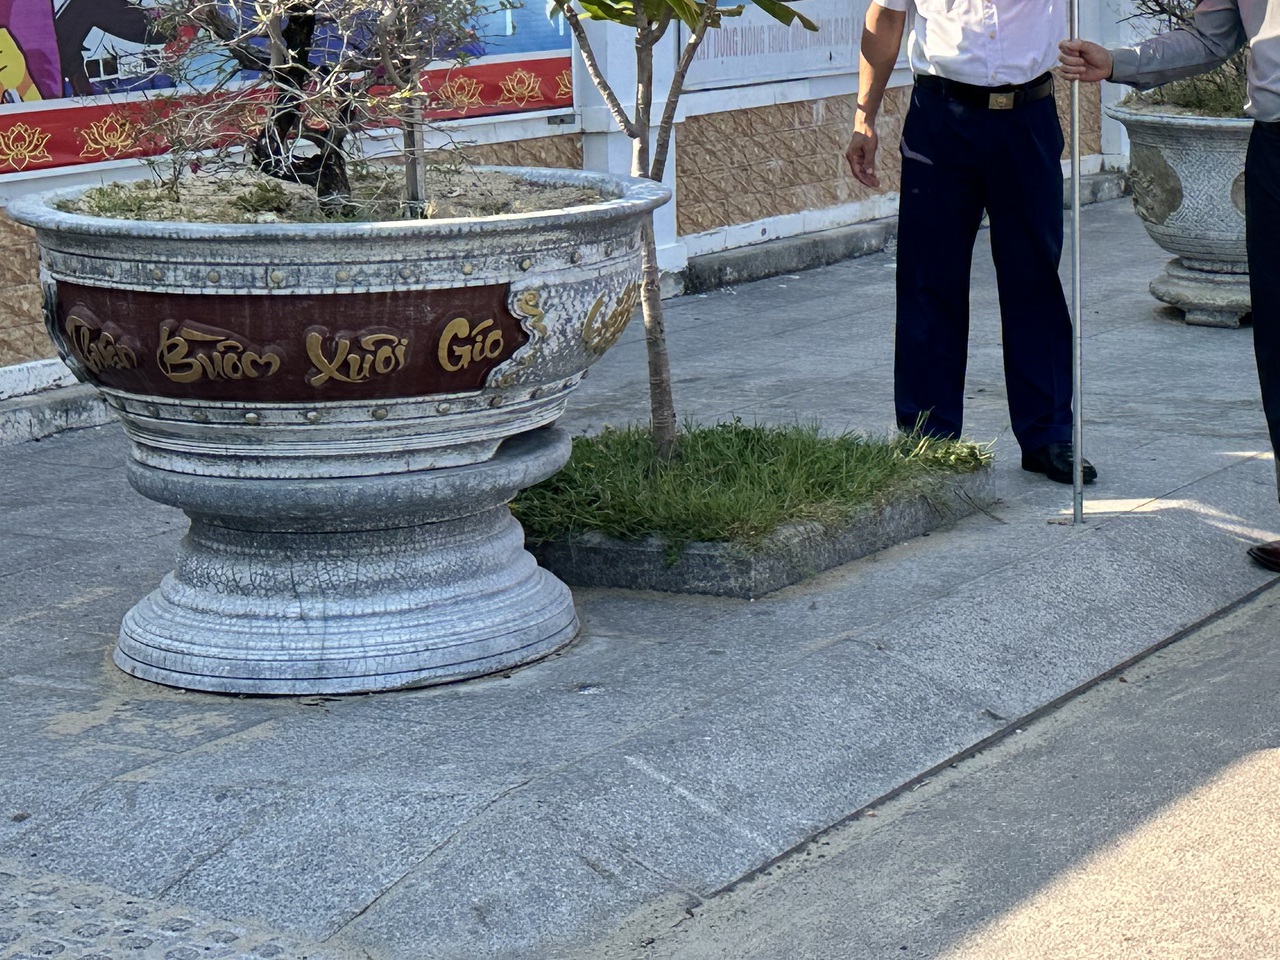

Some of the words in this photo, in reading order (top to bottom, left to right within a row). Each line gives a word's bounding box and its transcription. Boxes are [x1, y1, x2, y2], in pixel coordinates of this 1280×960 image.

[156, 326, 281, 383] Buồm
[305, 331, 409, 387] Xuôi
[437, 317, 503, 372] Gió
